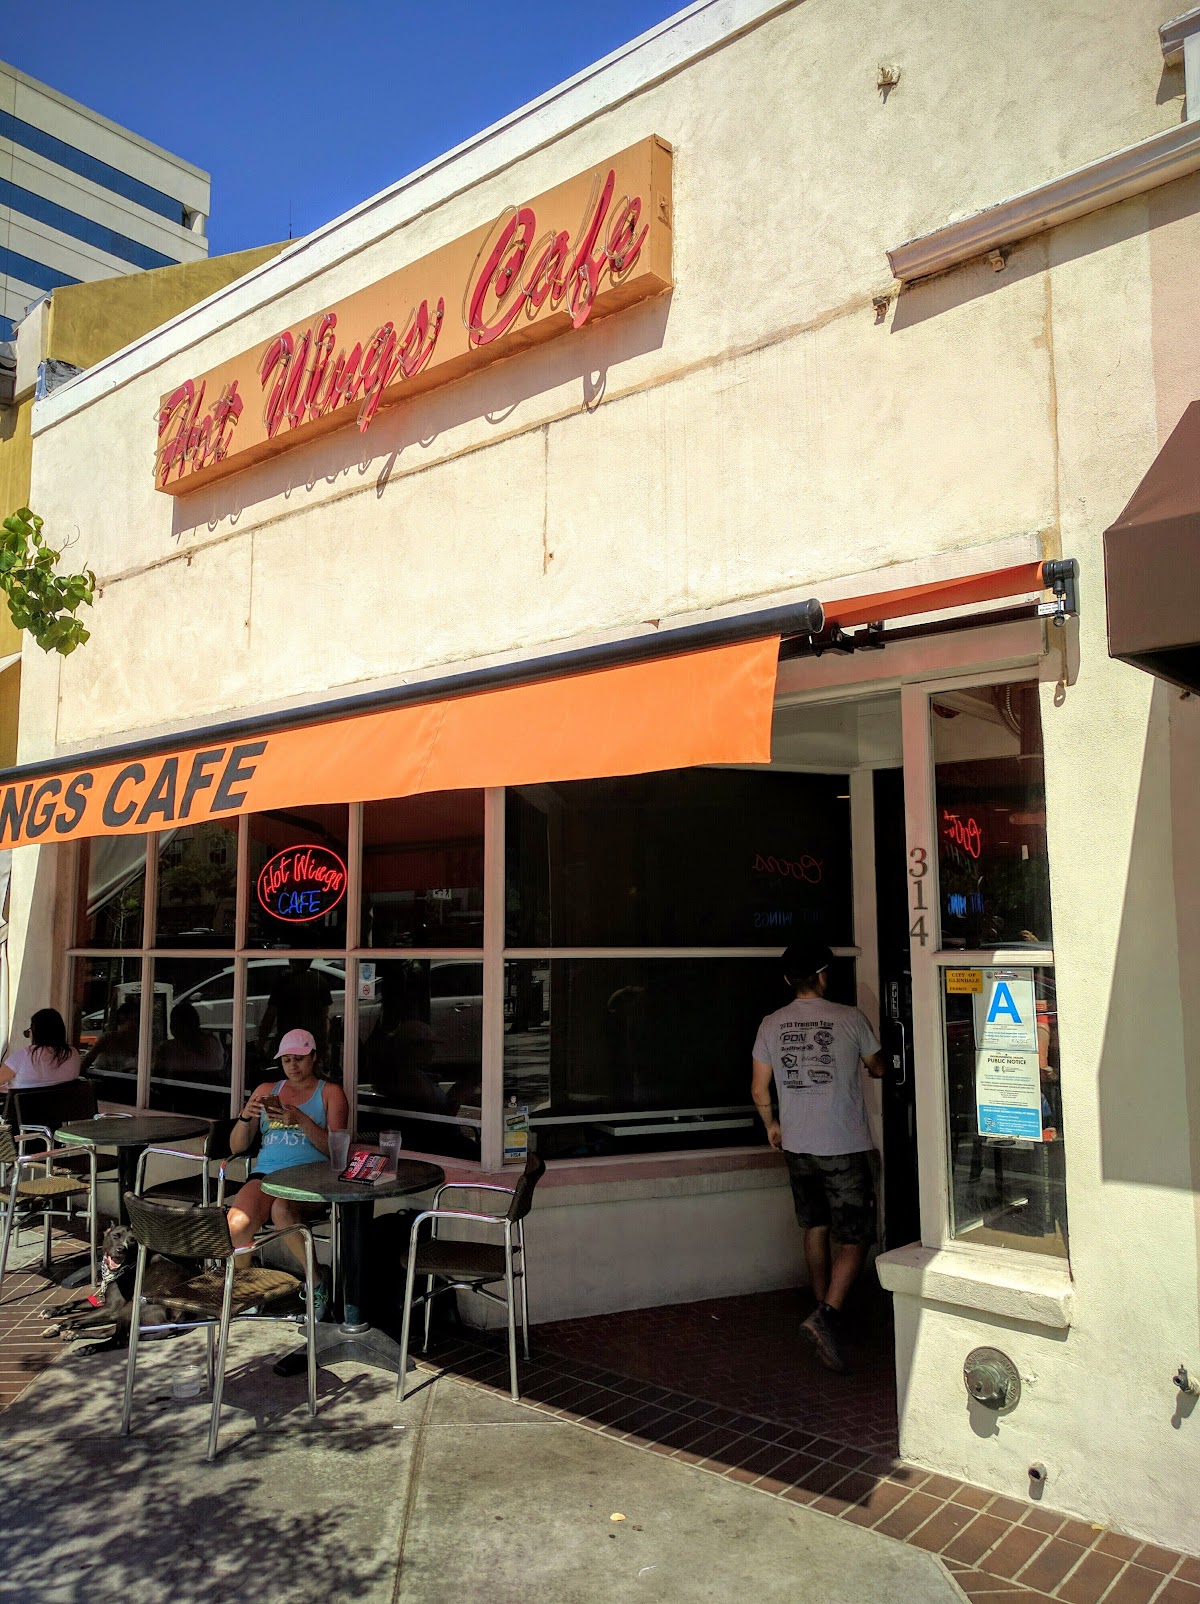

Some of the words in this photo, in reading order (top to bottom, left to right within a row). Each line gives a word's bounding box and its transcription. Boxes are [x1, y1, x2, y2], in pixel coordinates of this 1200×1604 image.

[154, 377, 243, 486] Hot
[258, 296, 445, 434] Wings
[463, 168, 650, 346] Cafe
[0, 771, 95, 843] NGS
[102, 740, 269, 828] CAFE
[263, 857, 291, 902] Hot
[293, 849, 344, 893] Wings
[277, 889, 322, 914] CAFE
[908, 847, 929, 946] 314
[986, 982, 1023, 1024] A
